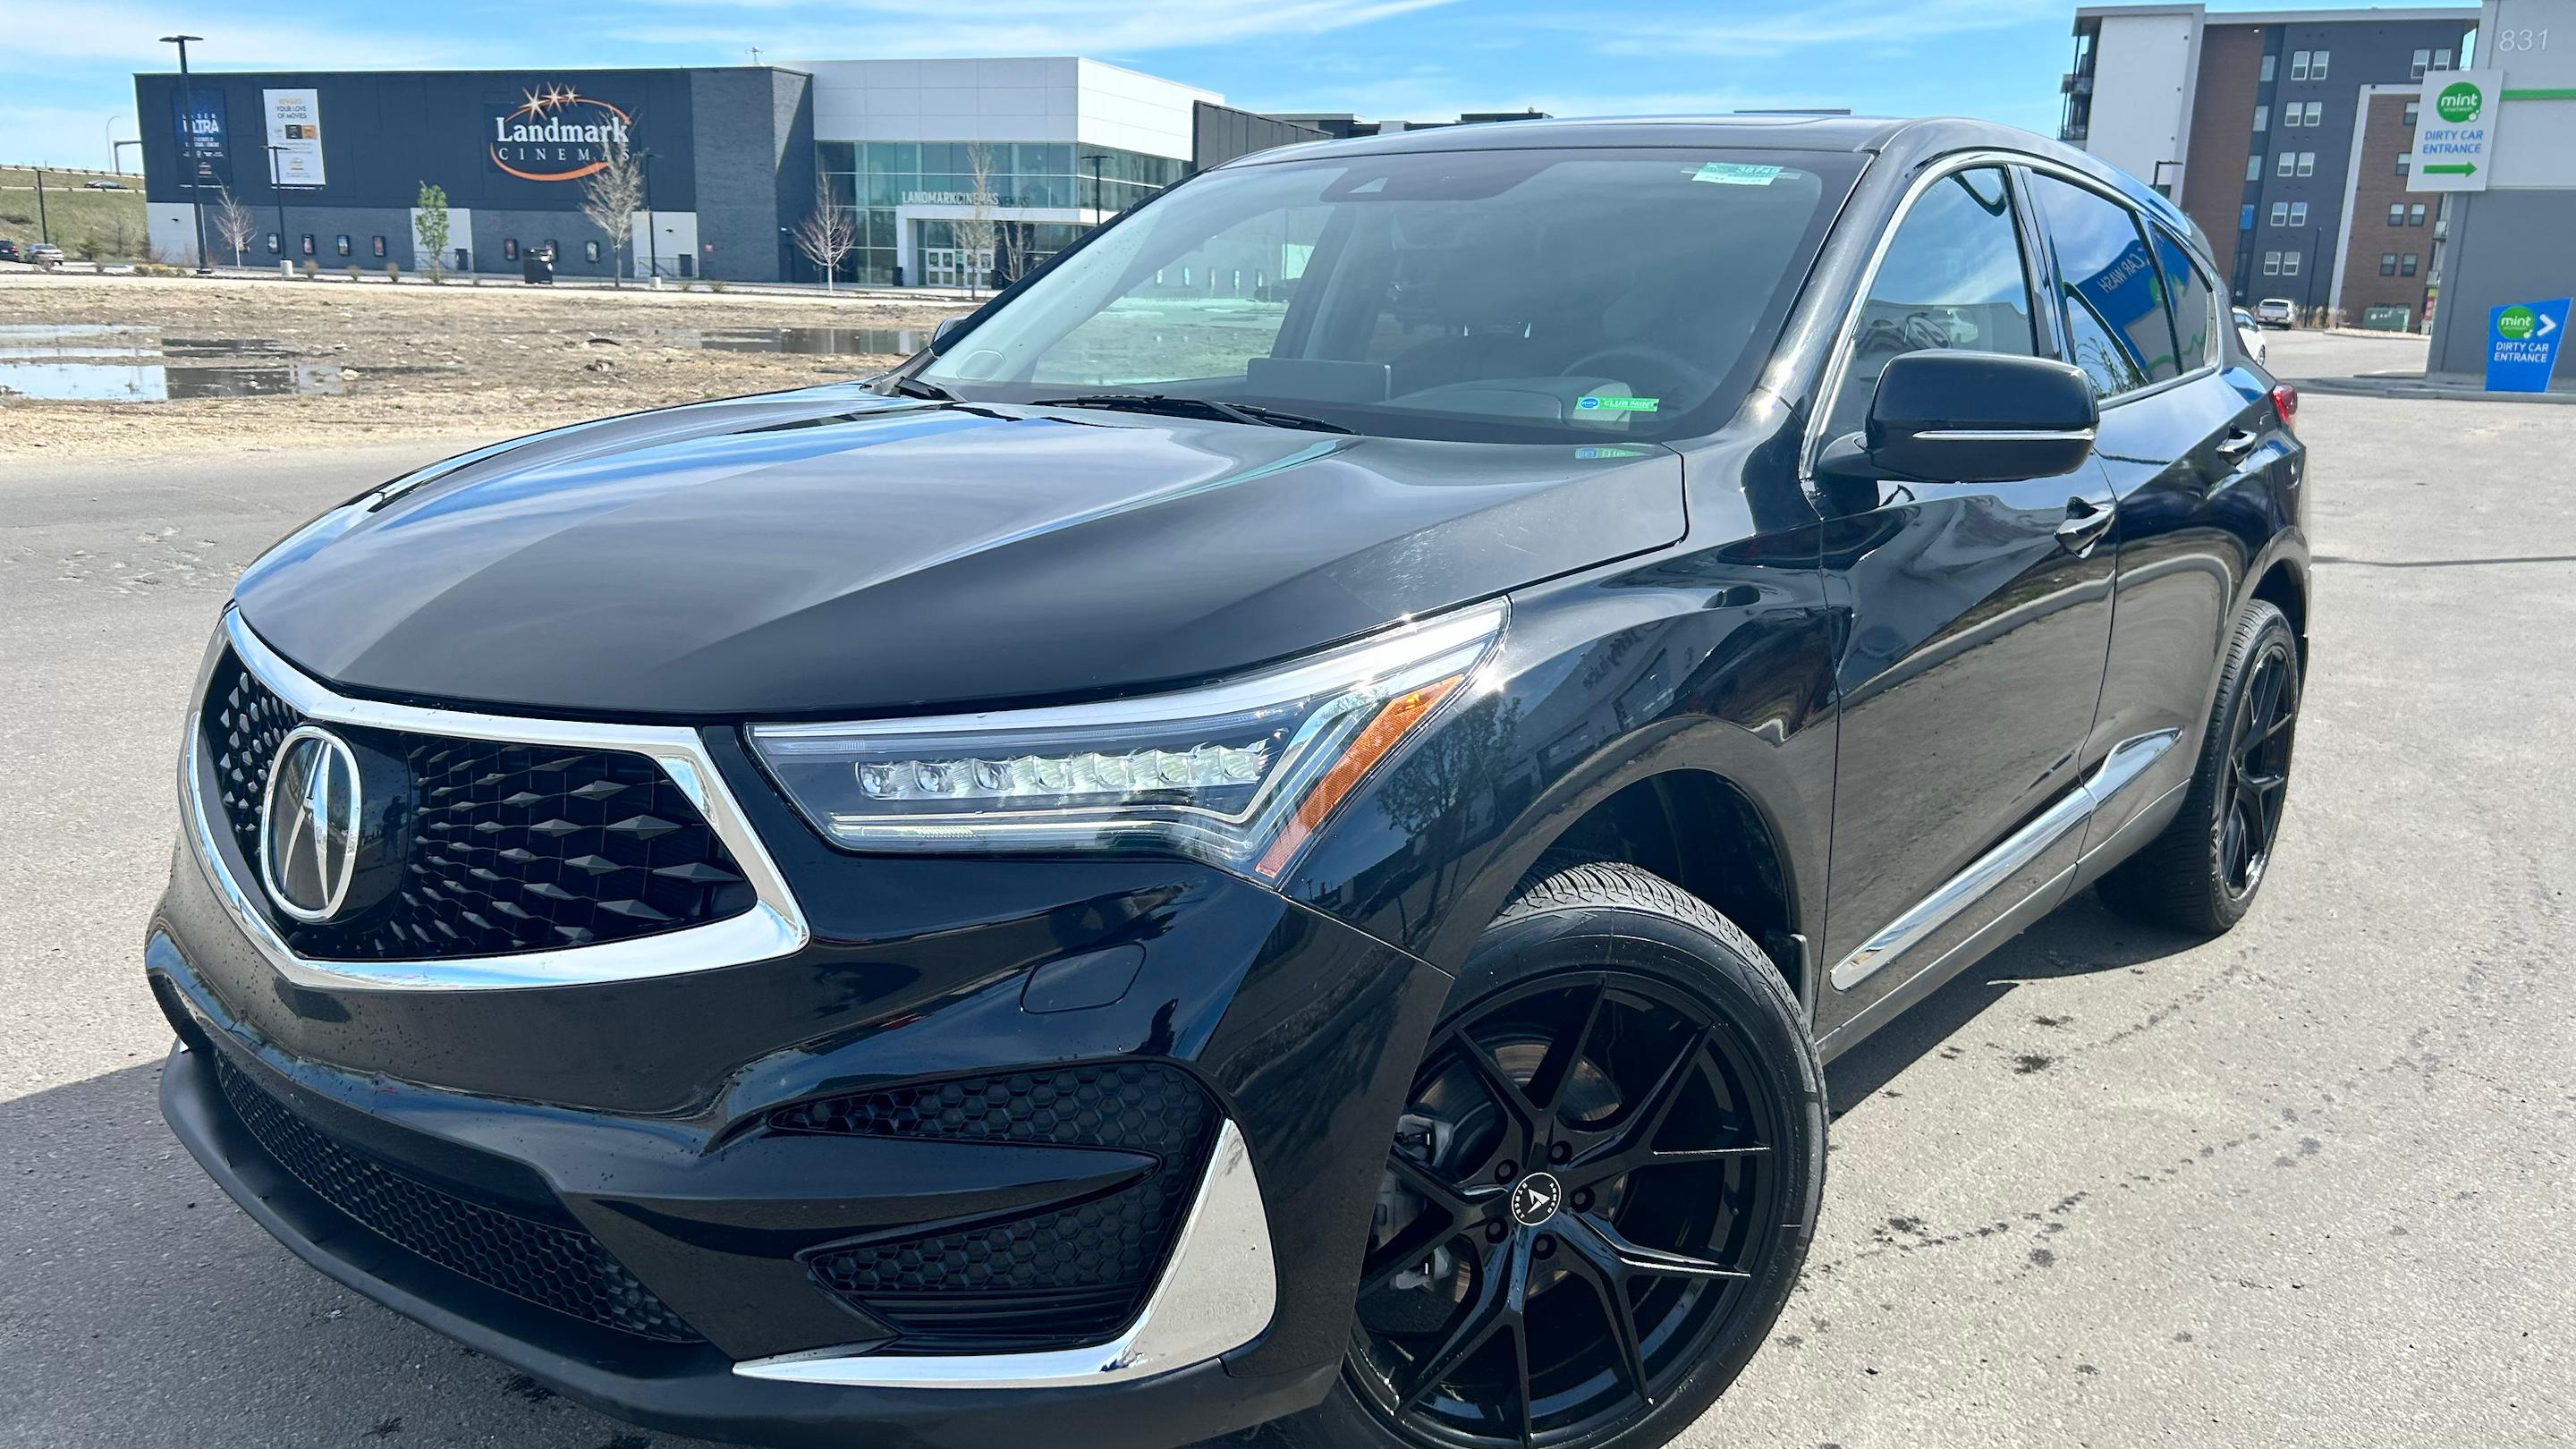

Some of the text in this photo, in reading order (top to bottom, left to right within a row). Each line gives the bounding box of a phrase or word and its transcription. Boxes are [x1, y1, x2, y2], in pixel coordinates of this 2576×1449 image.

[2499, 29, 2548, 52] 831
[2441, 93, 2478, 106] mint
[496, 116, 629, 143] Landmark
[2425, 130, 2484, 140] DIRTY CAR
[2423, 143, 2482, 154] ENTRANCE
[2501, 316, 2532, 326] mint
[2496, 342, 2549, 352] DIRTY CAR
[2494, 352, 2547, 363] ENTRANCE
